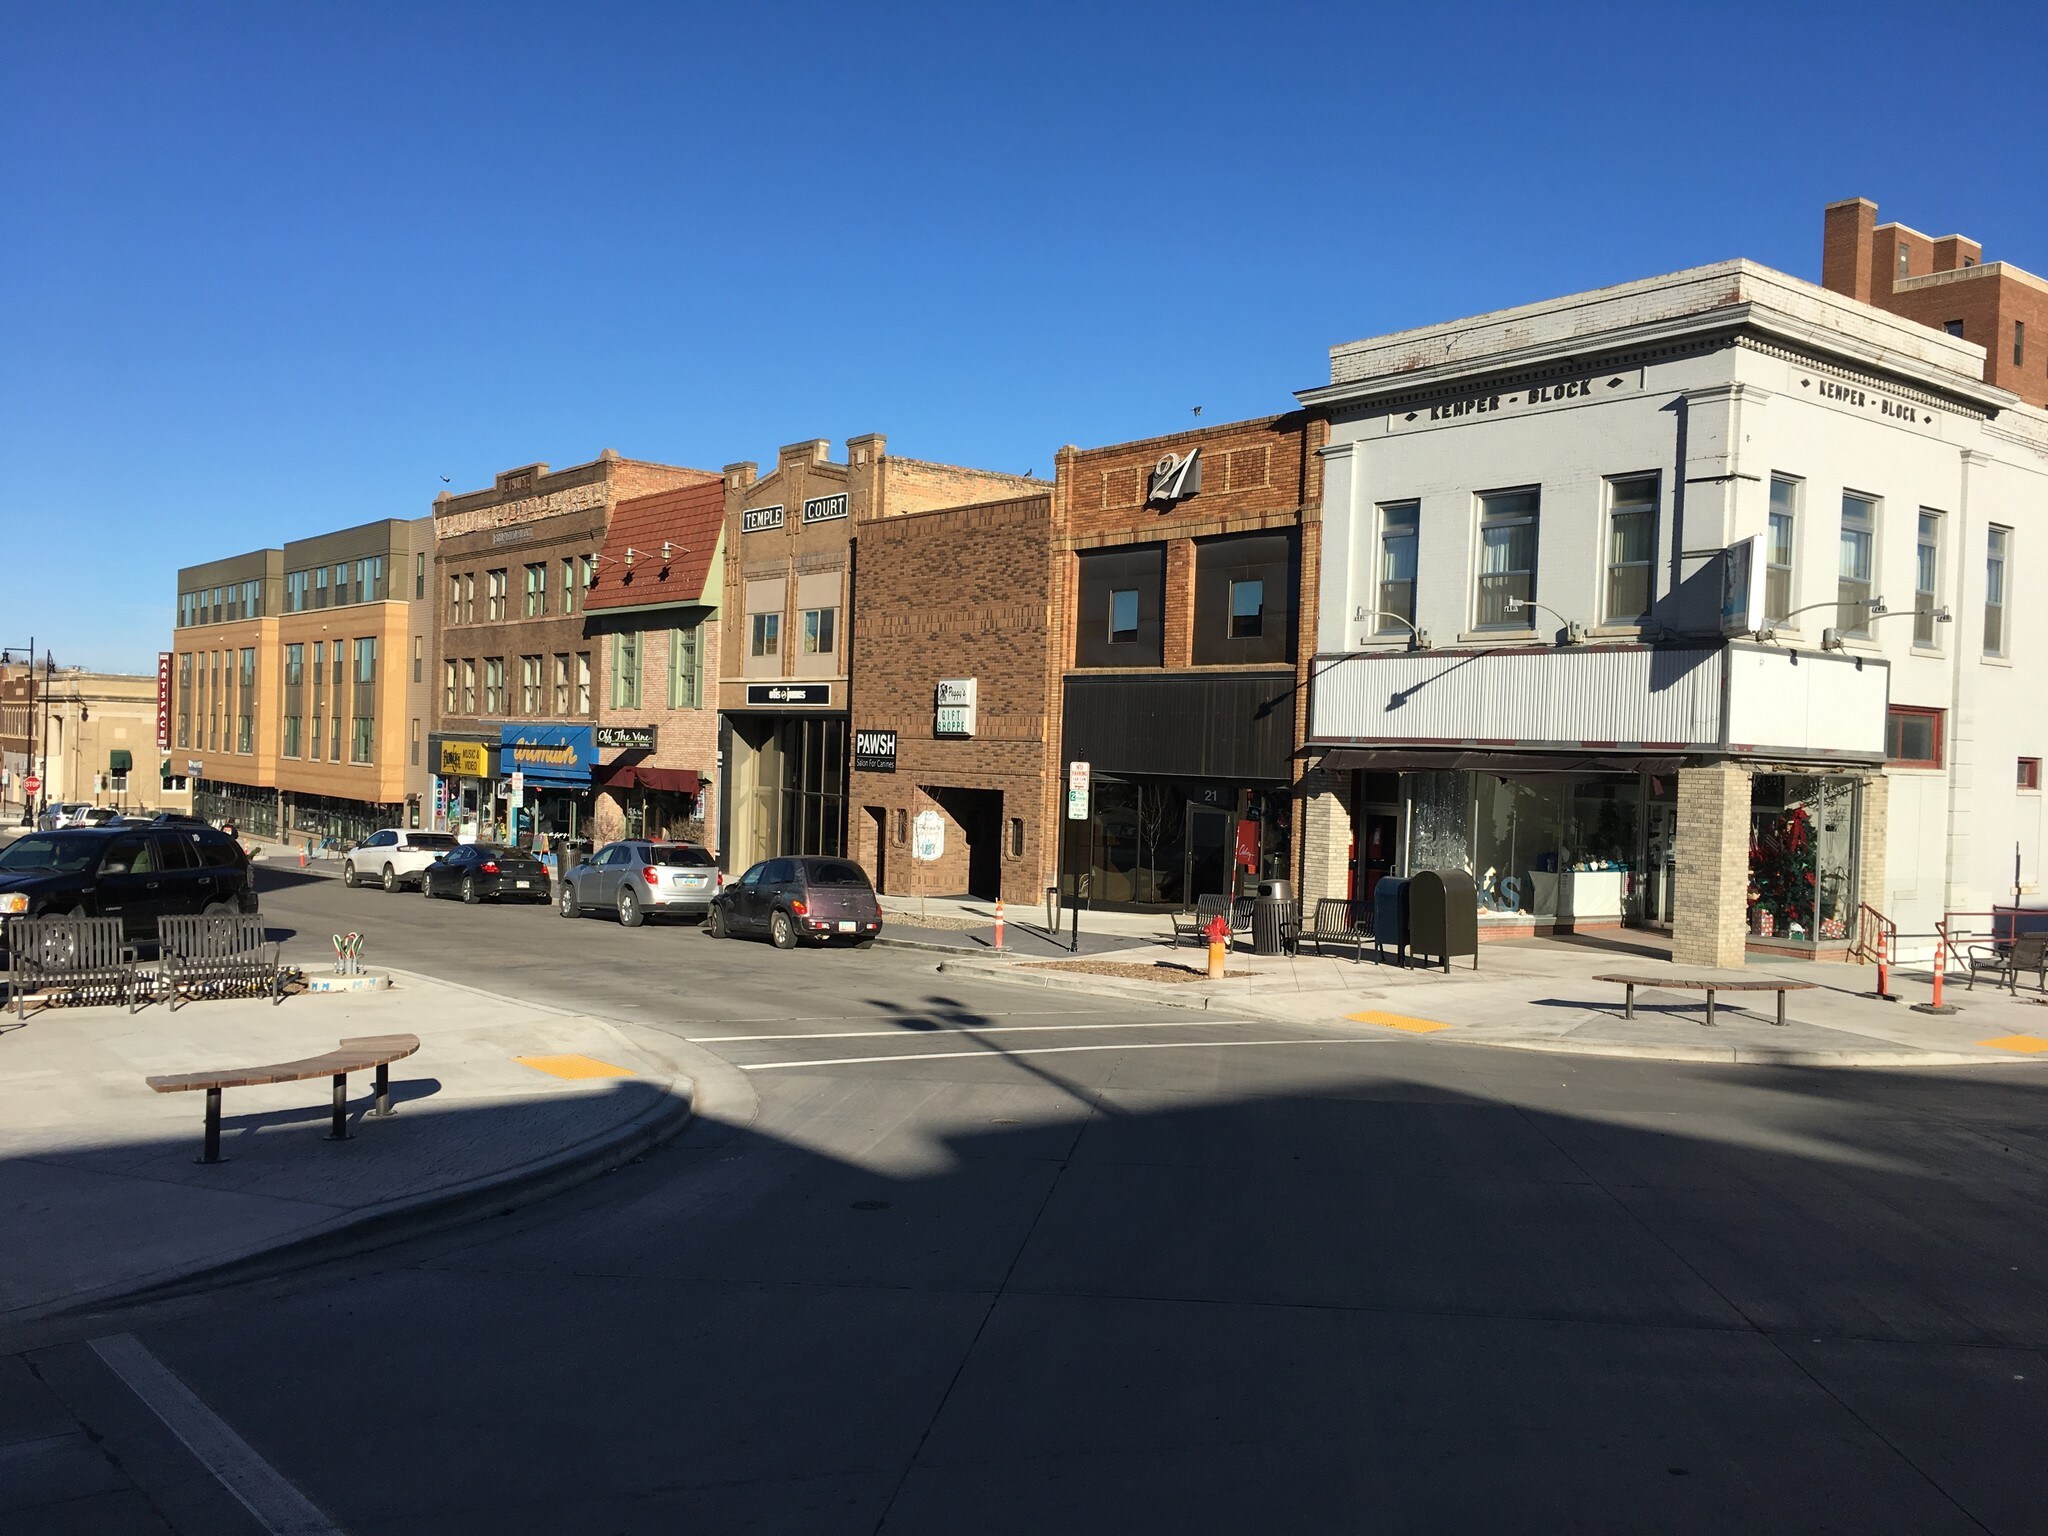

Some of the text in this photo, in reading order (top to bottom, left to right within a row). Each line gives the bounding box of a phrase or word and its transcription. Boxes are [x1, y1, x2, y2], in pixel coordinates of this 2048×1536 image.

[1430, 395, 1500, 421] KEMPER
[1528, 379, 1592, 405] BLOCK
[1819, 380, 1866, 407] KEMPER
[1881, 399, 1917, 423] BLOCK
[807, 497, 845, 518] COURT
[745, 508, 783, 529] TEMPLE
[160, 661, 168, 738] ARTSPACE
[941, 710, 961, 720] GIFT
[937, 721, 965, 732] SHOPPE
[598, 728, 651, 744] Off The Vine
[857, 733, 896, 755] PAWSH
[462, 748, 476, 759] MUSIC
[464, 760, 477, 771] VIDEO
[856, 758, 895, 769] Salon For Canines
[25, 780, 41, 788] STOP
[1204, 789, 1217, 802] 21
